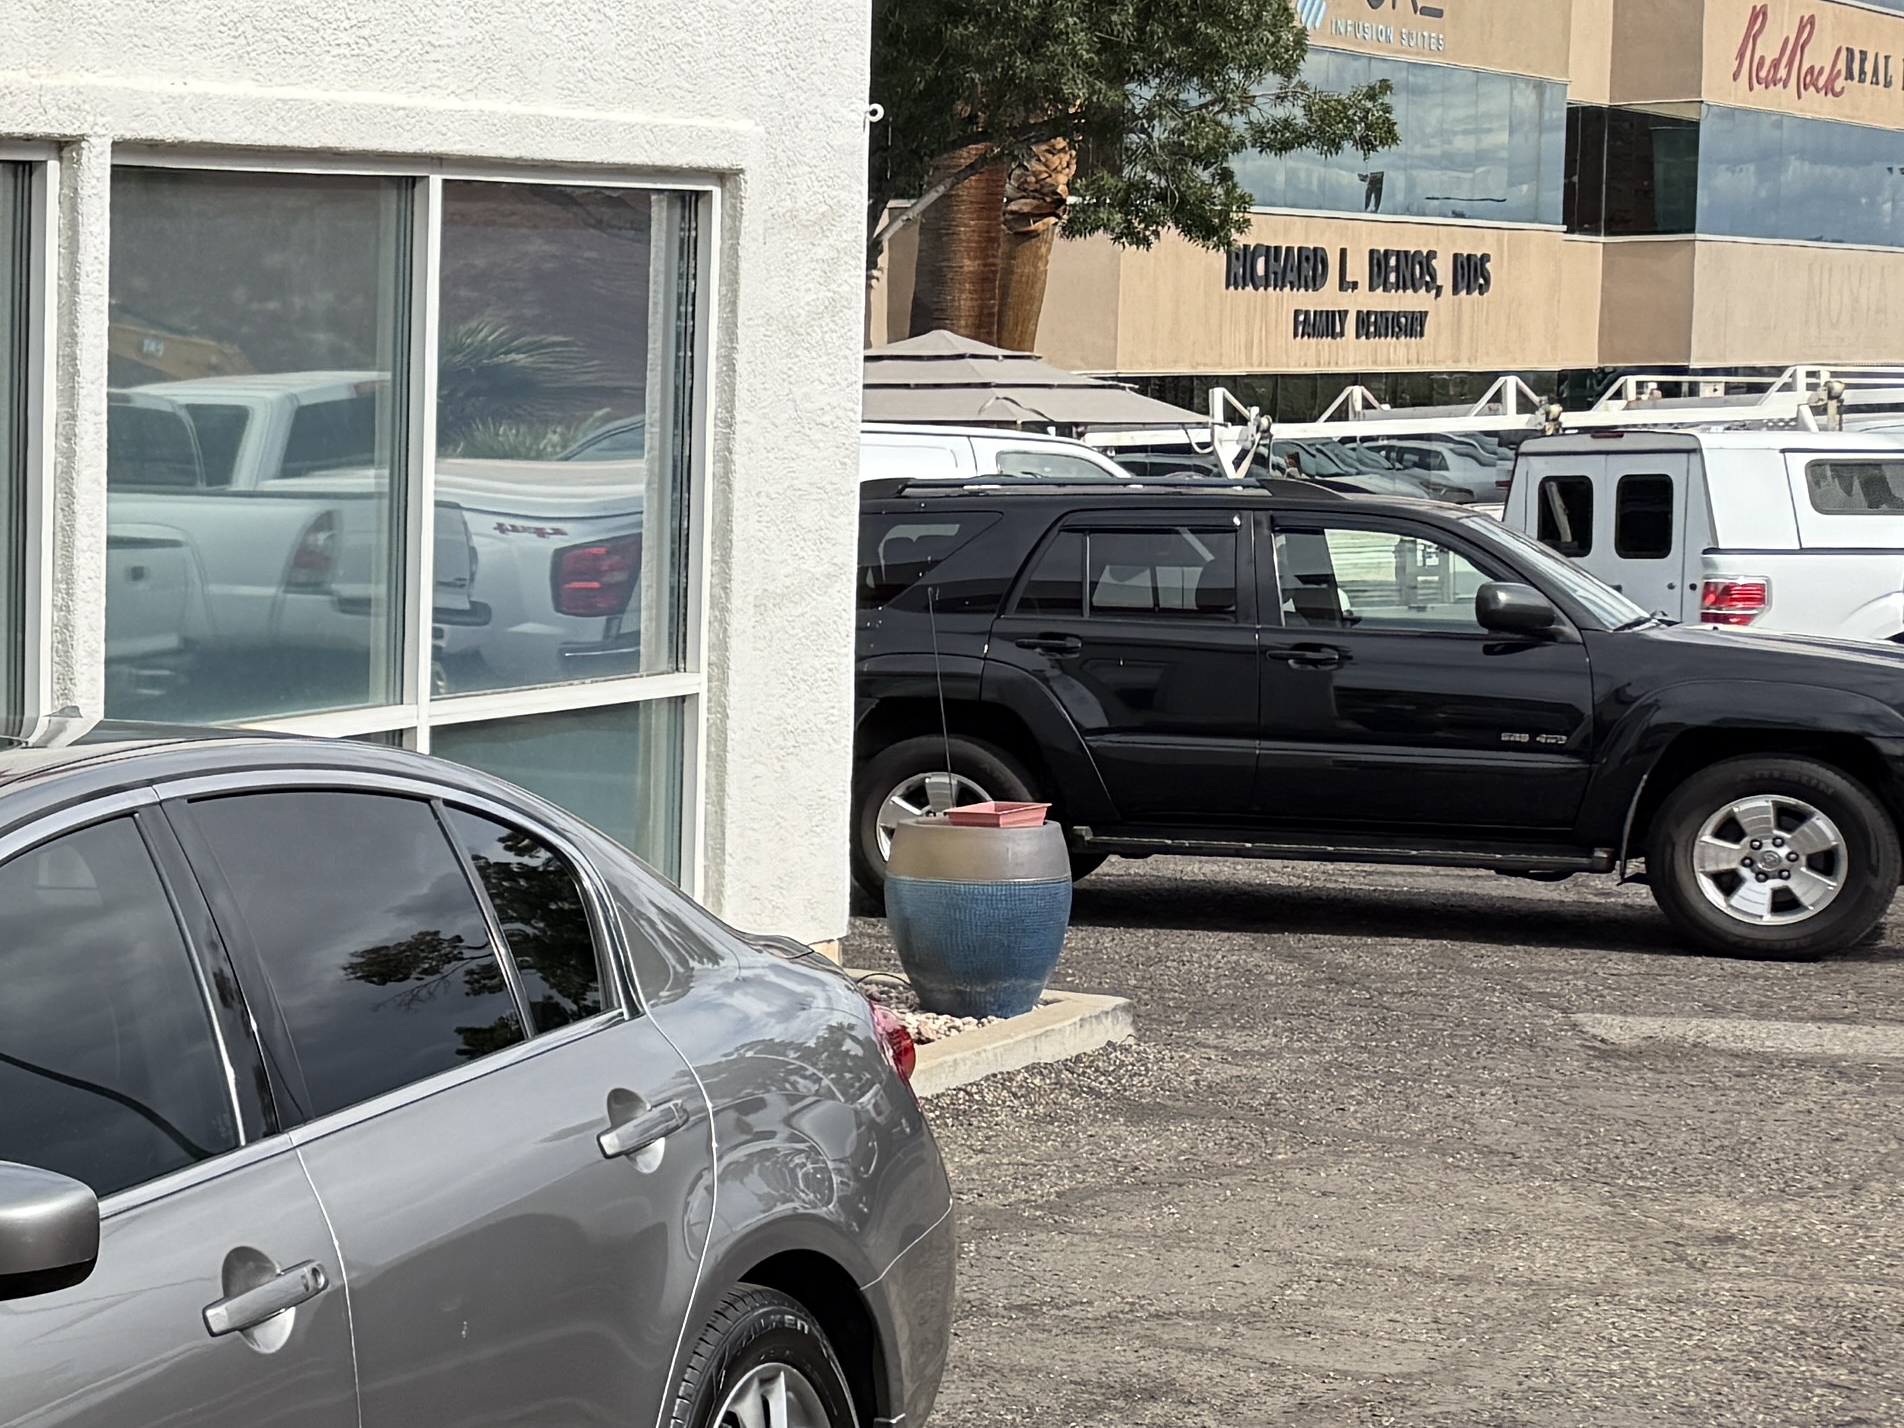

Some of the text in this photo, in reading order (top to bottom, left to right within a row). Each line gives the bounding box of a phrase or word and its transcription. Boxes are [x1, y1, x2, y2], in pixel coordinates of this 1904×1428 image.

[1330, 18, 1445, 52] INFUSION SUITES
[1844, 46, 1893, 89] REAL
[1225, 243, 1491, 300] RICHARD L. DENOS, DDS
[1293, 309, 1430, 341] FAMILY DENTISTRY
